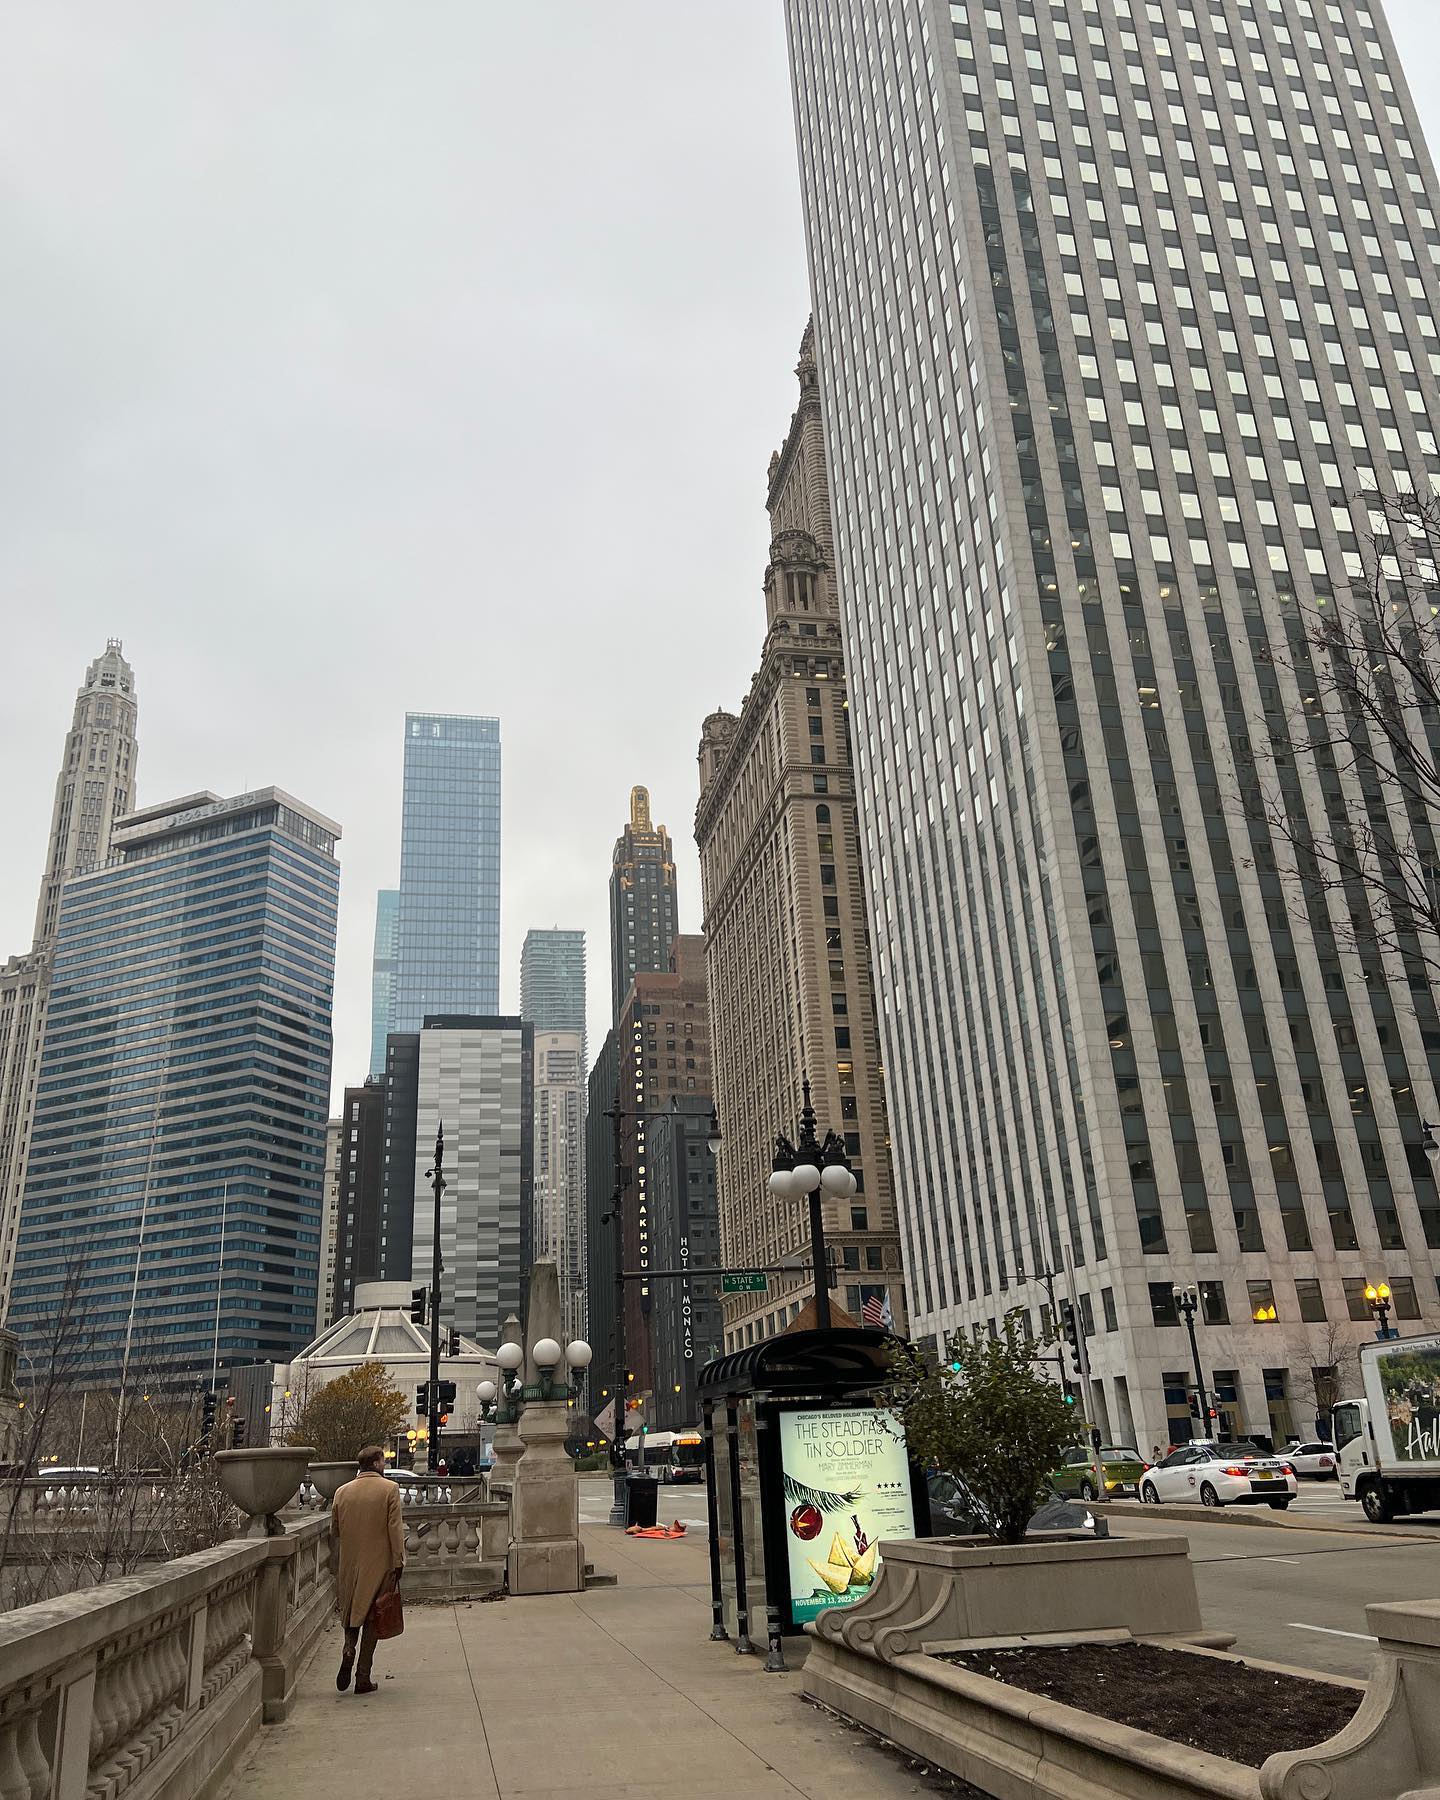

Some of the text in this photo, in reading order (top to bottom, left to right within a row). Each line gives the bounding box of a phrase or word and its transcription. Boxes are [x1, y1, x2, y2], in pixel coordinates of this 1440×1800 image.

[633, 1020, 649, 1296] MORTONS THE STEAKHOUE
[731, 1276, 754, 1285] STATE
[680, 1237, 693, 1359] HOTL MONACO
[795, 1419, 888, 1440] THE STEADFAS
[825, 1439, 884, 1458] SOLDIER
[795, 1597, 826, 1607] NOVEMBER
[828, 1596, 837, 1604] 13,
